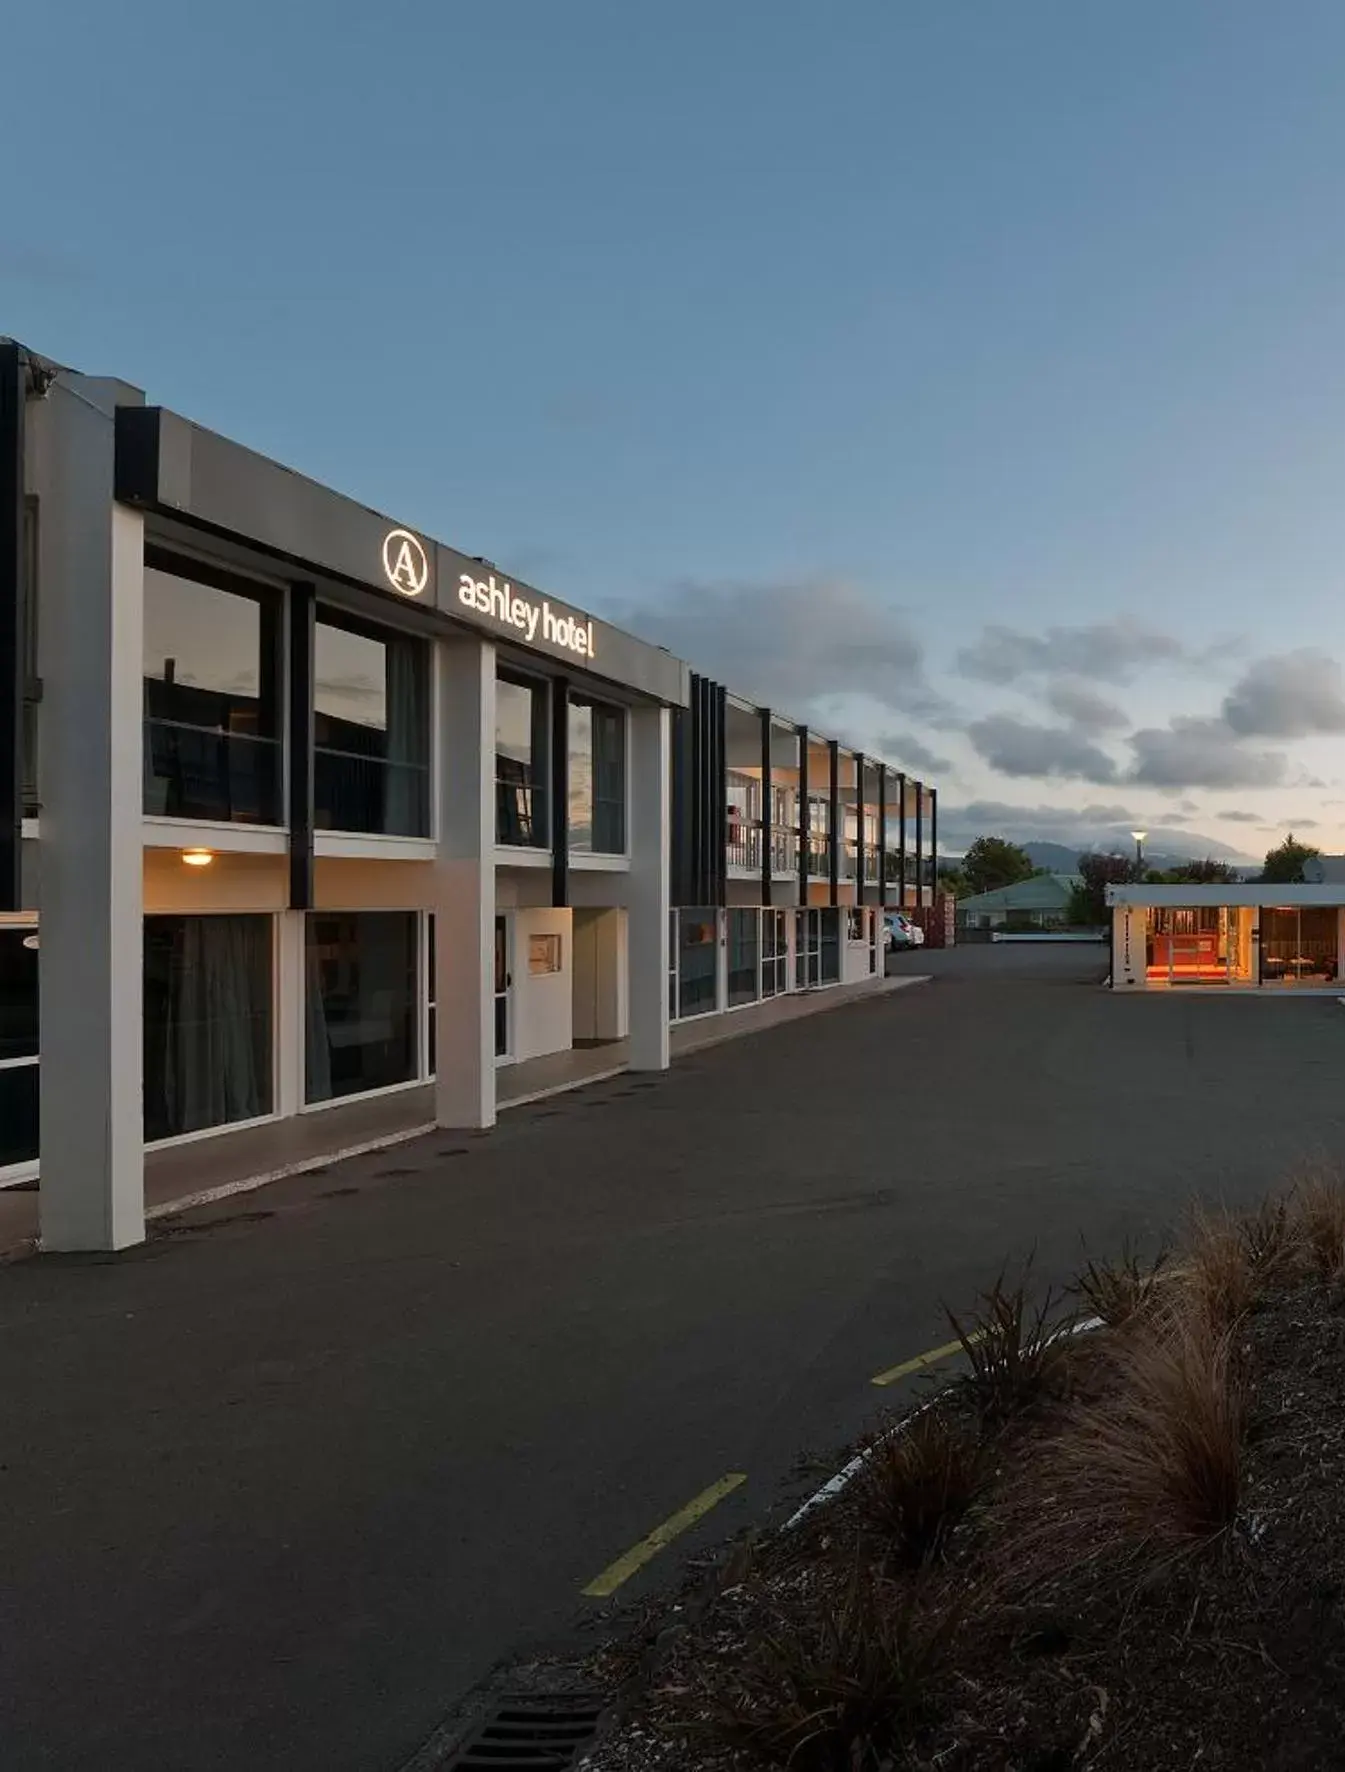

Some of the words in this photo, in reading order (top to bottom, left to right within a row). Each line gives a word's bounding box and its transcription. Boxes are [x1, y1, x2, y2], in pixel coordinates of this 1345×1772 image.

[393, 541, 418, 587] A
[458, 574, 541, 641] ashley
[543, 602, 594, 657] hotel
